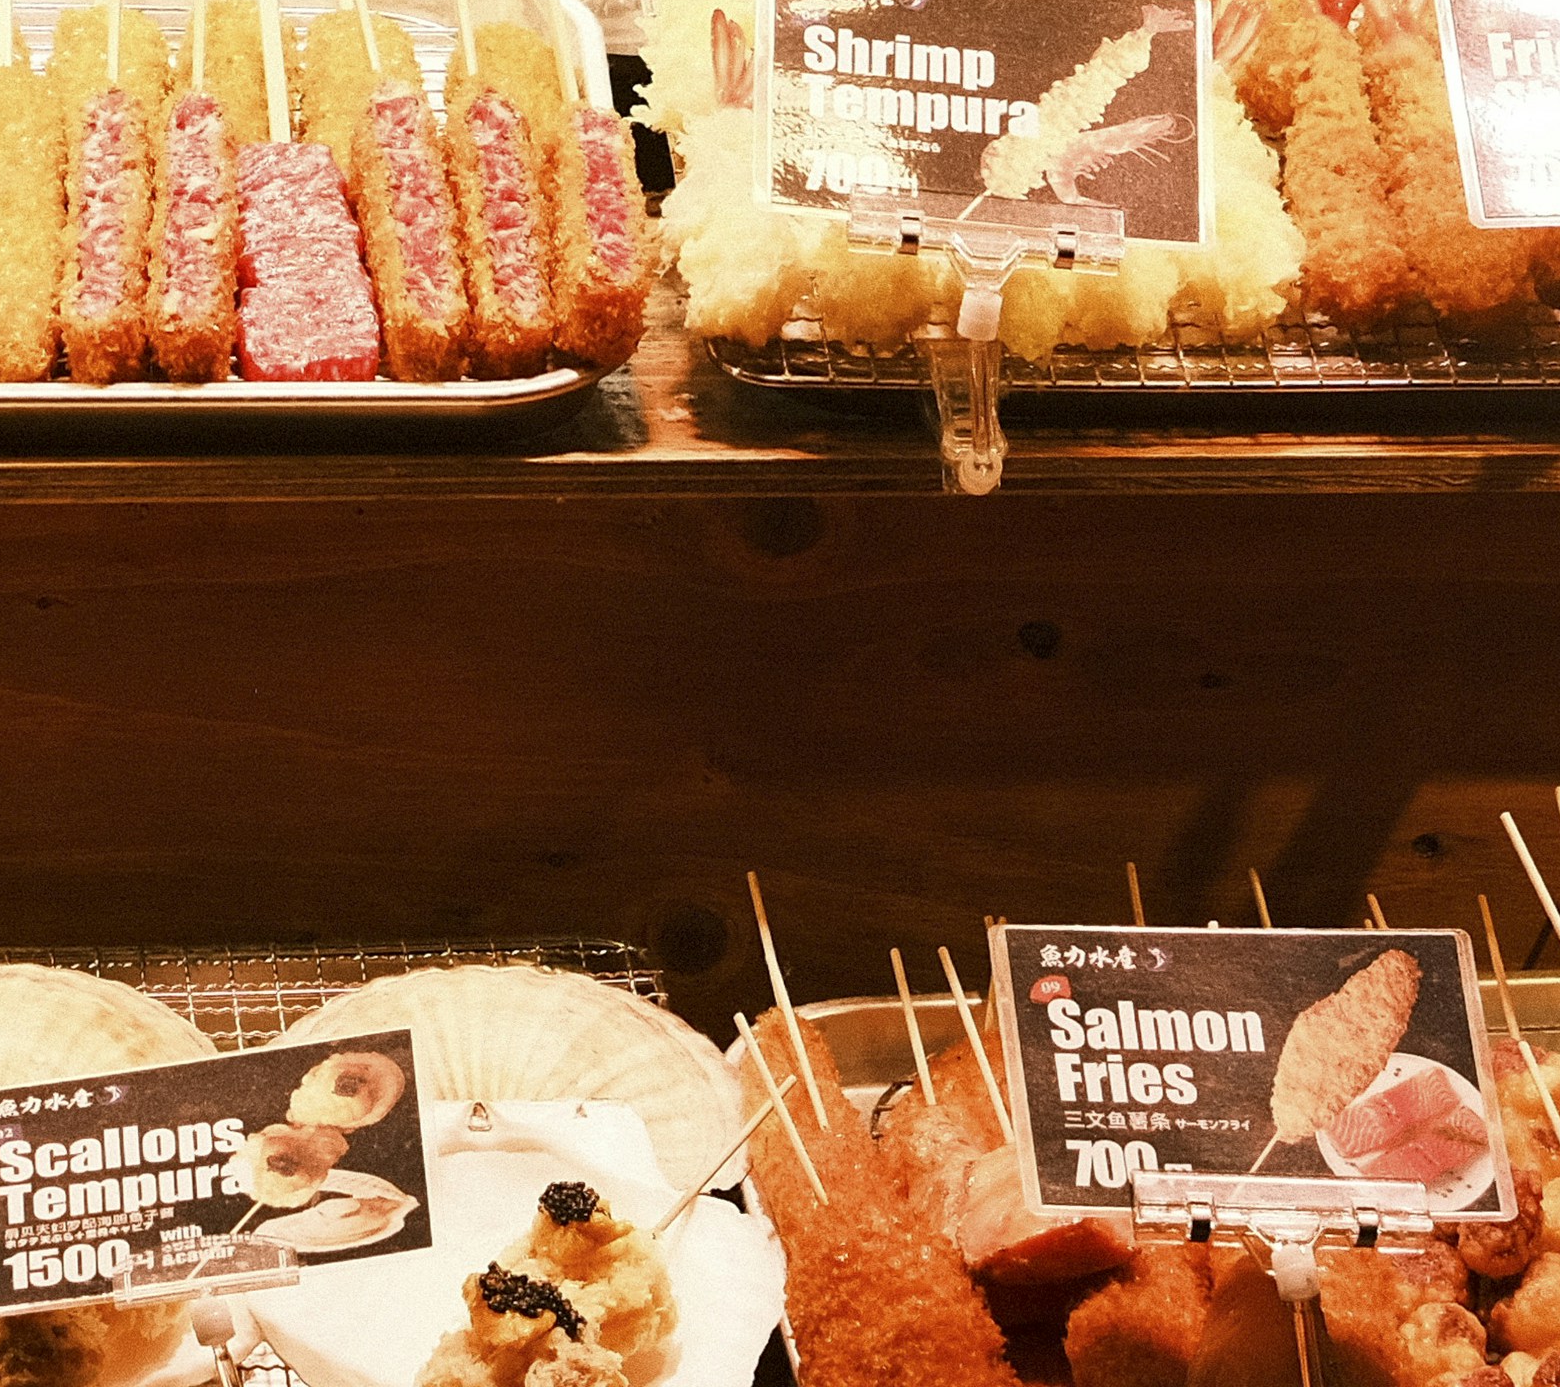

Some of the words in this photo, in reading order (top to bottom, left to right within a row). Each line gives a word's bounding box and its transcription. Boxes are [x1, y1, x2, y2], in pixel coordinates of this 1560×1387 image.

[802, 23, 996, 89] Shrimp
[801, 72, 1040, 138] Tempura
[1047, 998, 1266, 1053] Salmon
[1055, 1053, 1198, 1106] Fries
[159, 1223, 203, 1244] with
